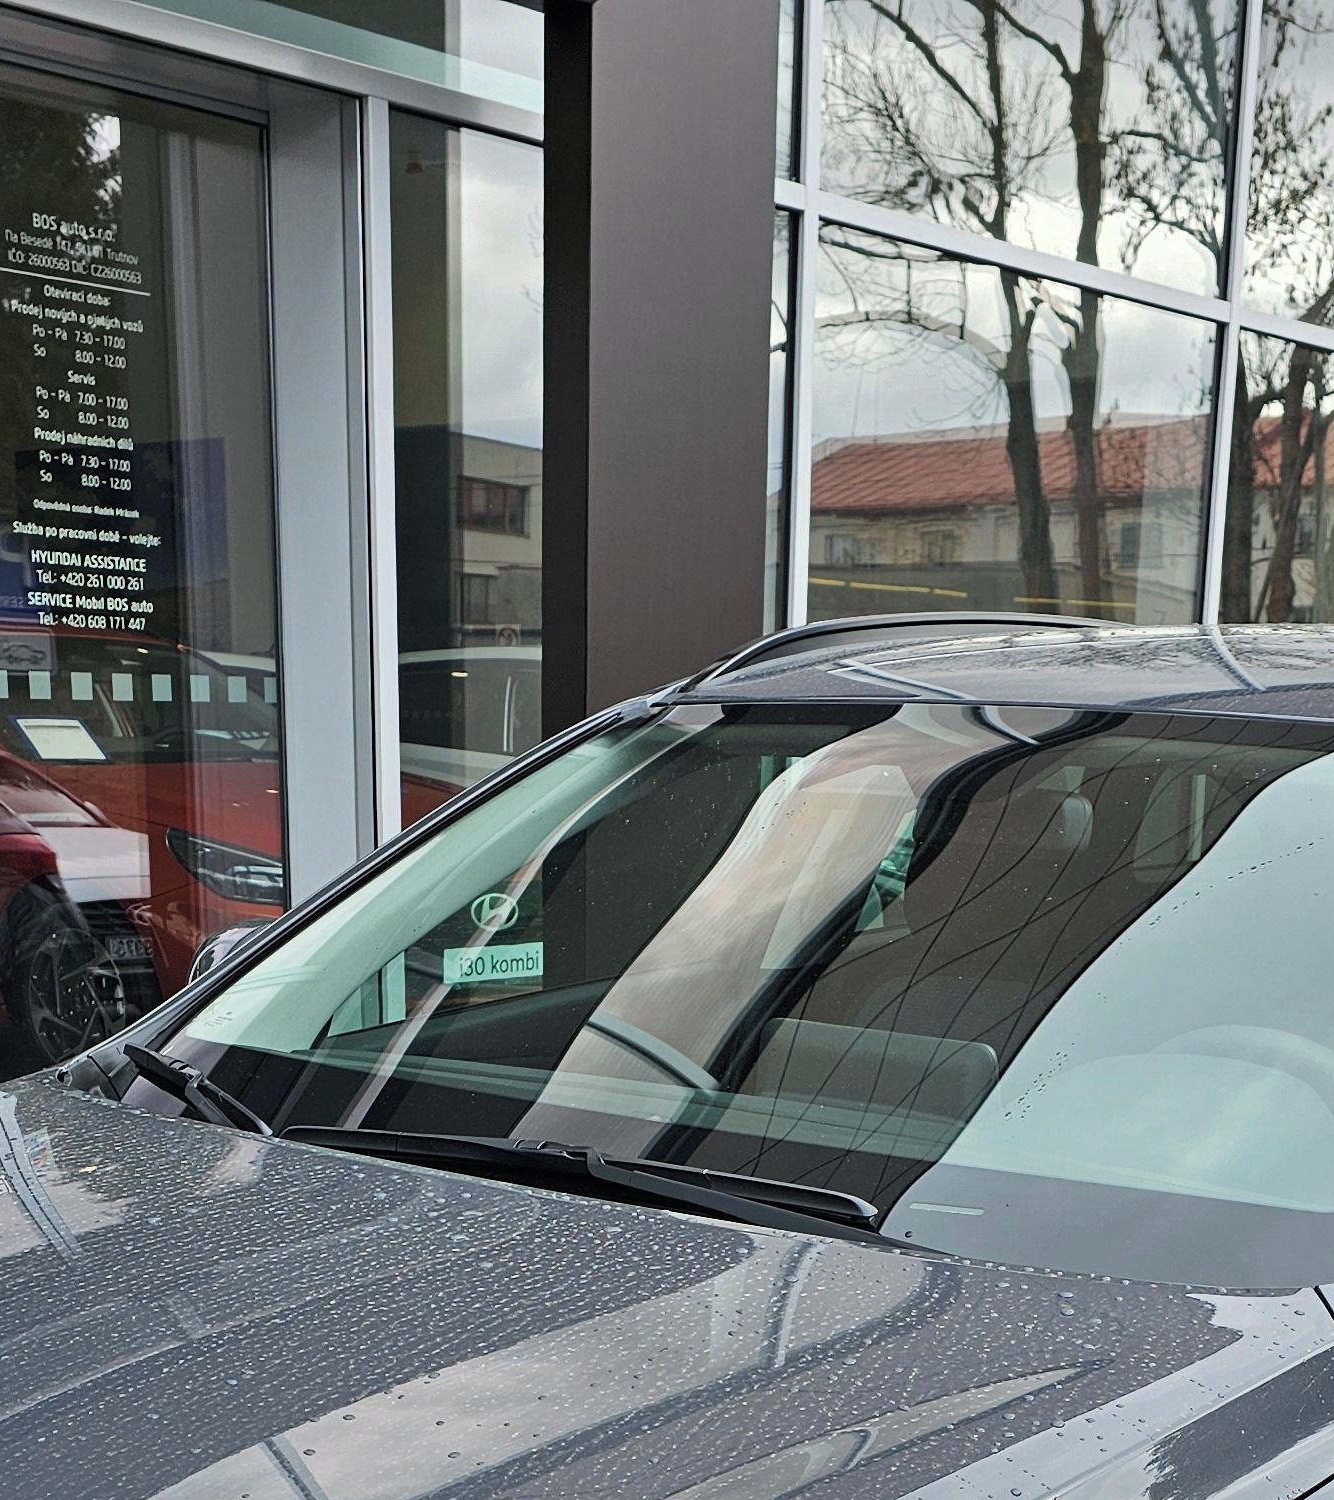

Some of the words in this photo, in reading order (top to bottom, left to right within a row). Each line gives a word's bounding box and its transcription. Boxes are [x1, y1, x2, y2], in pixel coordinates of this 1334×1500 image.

[32, 212, 58, 230] BOS
[5, 229, 18, 243] Na
[106, 248, 139, 265] Trutnov
[11, 299, 43, 319] Prodej
[45, 306, 78, 323] nových
[79, 313, 86, 324] a
[87, 313, 121, 330] ojetých
[122, 319, 144, 333] vozů
[32, 323, 46, 337] Po
[55, 327, 68, 341] Pá
[75, 330, 94, 345] 7.30
[103, 335, 126, 349] 17.00
[33, 343, 47, 357] So
[75, 350, 95, 364] 8.00
[104, 354, 127, 369] 12.00
[67, 370, 96, 386] Servis
[36, 386, 49, 400] Po
[58, 389, 71, 403] Pá
[77, 392, 97, 406] 7.00
[106, 395, 129, 410] 17.00
[36, 406, 50, 419] So
[78, 411, 97, 425] 8.00
[107, 415, 129, 429] 12.00
[34, 427, 66, 445] Prodej
[39, 450, 52, 463] Po
[61, 452, 74, 466] Pá
[80, 455, 99, 468] 7.30
[108, 458, 131, 472] 17.00
[39, 469, 53, 482] So
[81, 473, 100, 488] 8.00
[109, 477, 132, 491] 12.00
[12, 520, 44, 536] Služba
[45, 526, 58, 538] po
[58, 528, 97, 541] pracovní
[98, 529, 120, 542] době
[129, 533, 161, 548] volejte:
[31, 549, 81, 567] HYUNDAI
[83, 554, 147, 573] ASSISTANCE
[36, 569, 57, 584] Tel.:
[59, 572, 85, 587] +420
[86, 573, 104, 588] 261
[107, 575, 126, 589] 000
[127, 577, 144, 591] 261
[27, 591, 74, 608] SERVICE
[75, 594, 105, 610] Mobil
[106, 597, 129, 612] BOS
[130, 600, 154, 613] auto
[37, 611, 58, 626] Tel.:
[61, 613, 86, 628] +420
[87, 615, 106, 629] 608
[109, 616, 125, 630] 171
[128, 617, 146, 631] 447
[459, 956, 485, 977] i30
[490, 950, 540, 974] kombi
